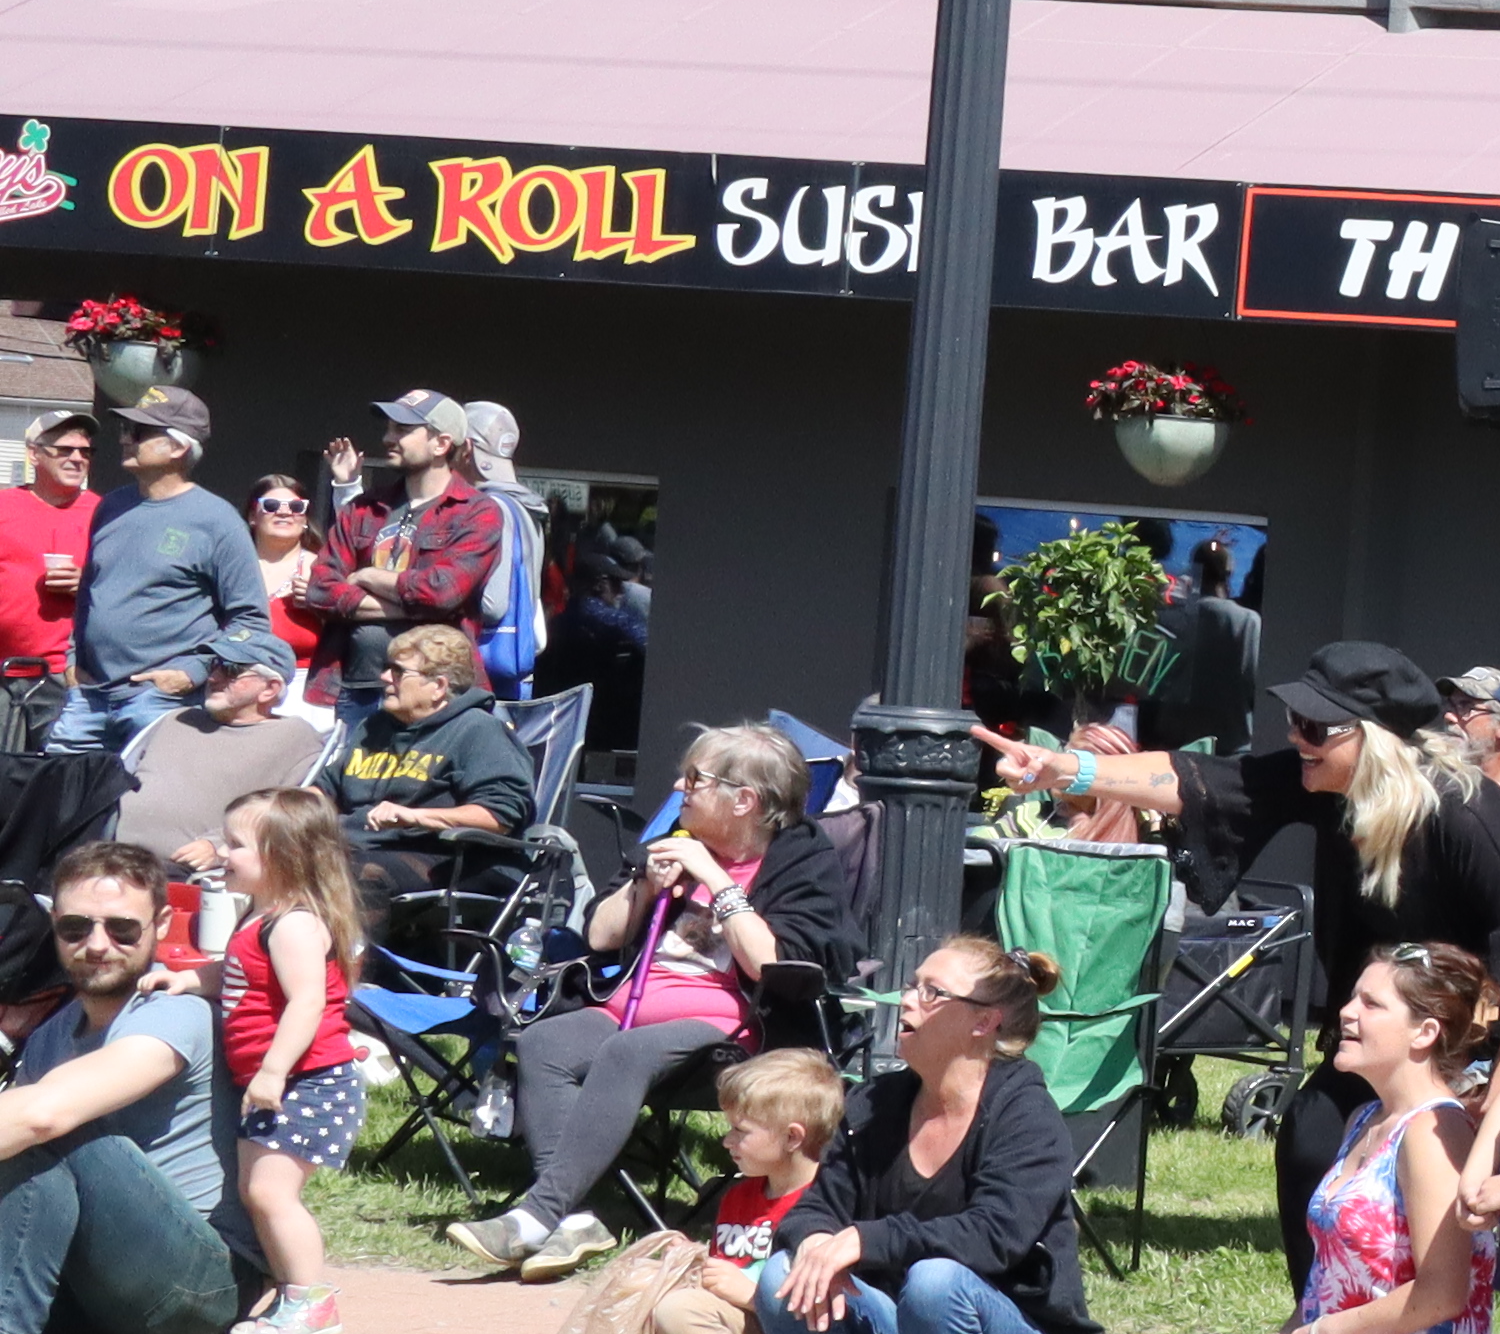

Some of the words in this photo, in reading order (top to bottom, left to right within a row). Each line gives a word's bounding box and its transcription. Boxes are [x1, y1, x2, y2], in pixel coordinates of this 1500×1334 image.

[108, 143, 269, 240] ON
[301, 144, 413, 247] A
[428, 156, 696, 264] ROLL
[716, 177, 924, 274] SUS
[1032, 196, 1220, 297] BAR
[1339, 219, 1460, 301] TH
[1227, 919, 1256, 927] MAC
[716, 1220, 773, 1260] POKÉ
